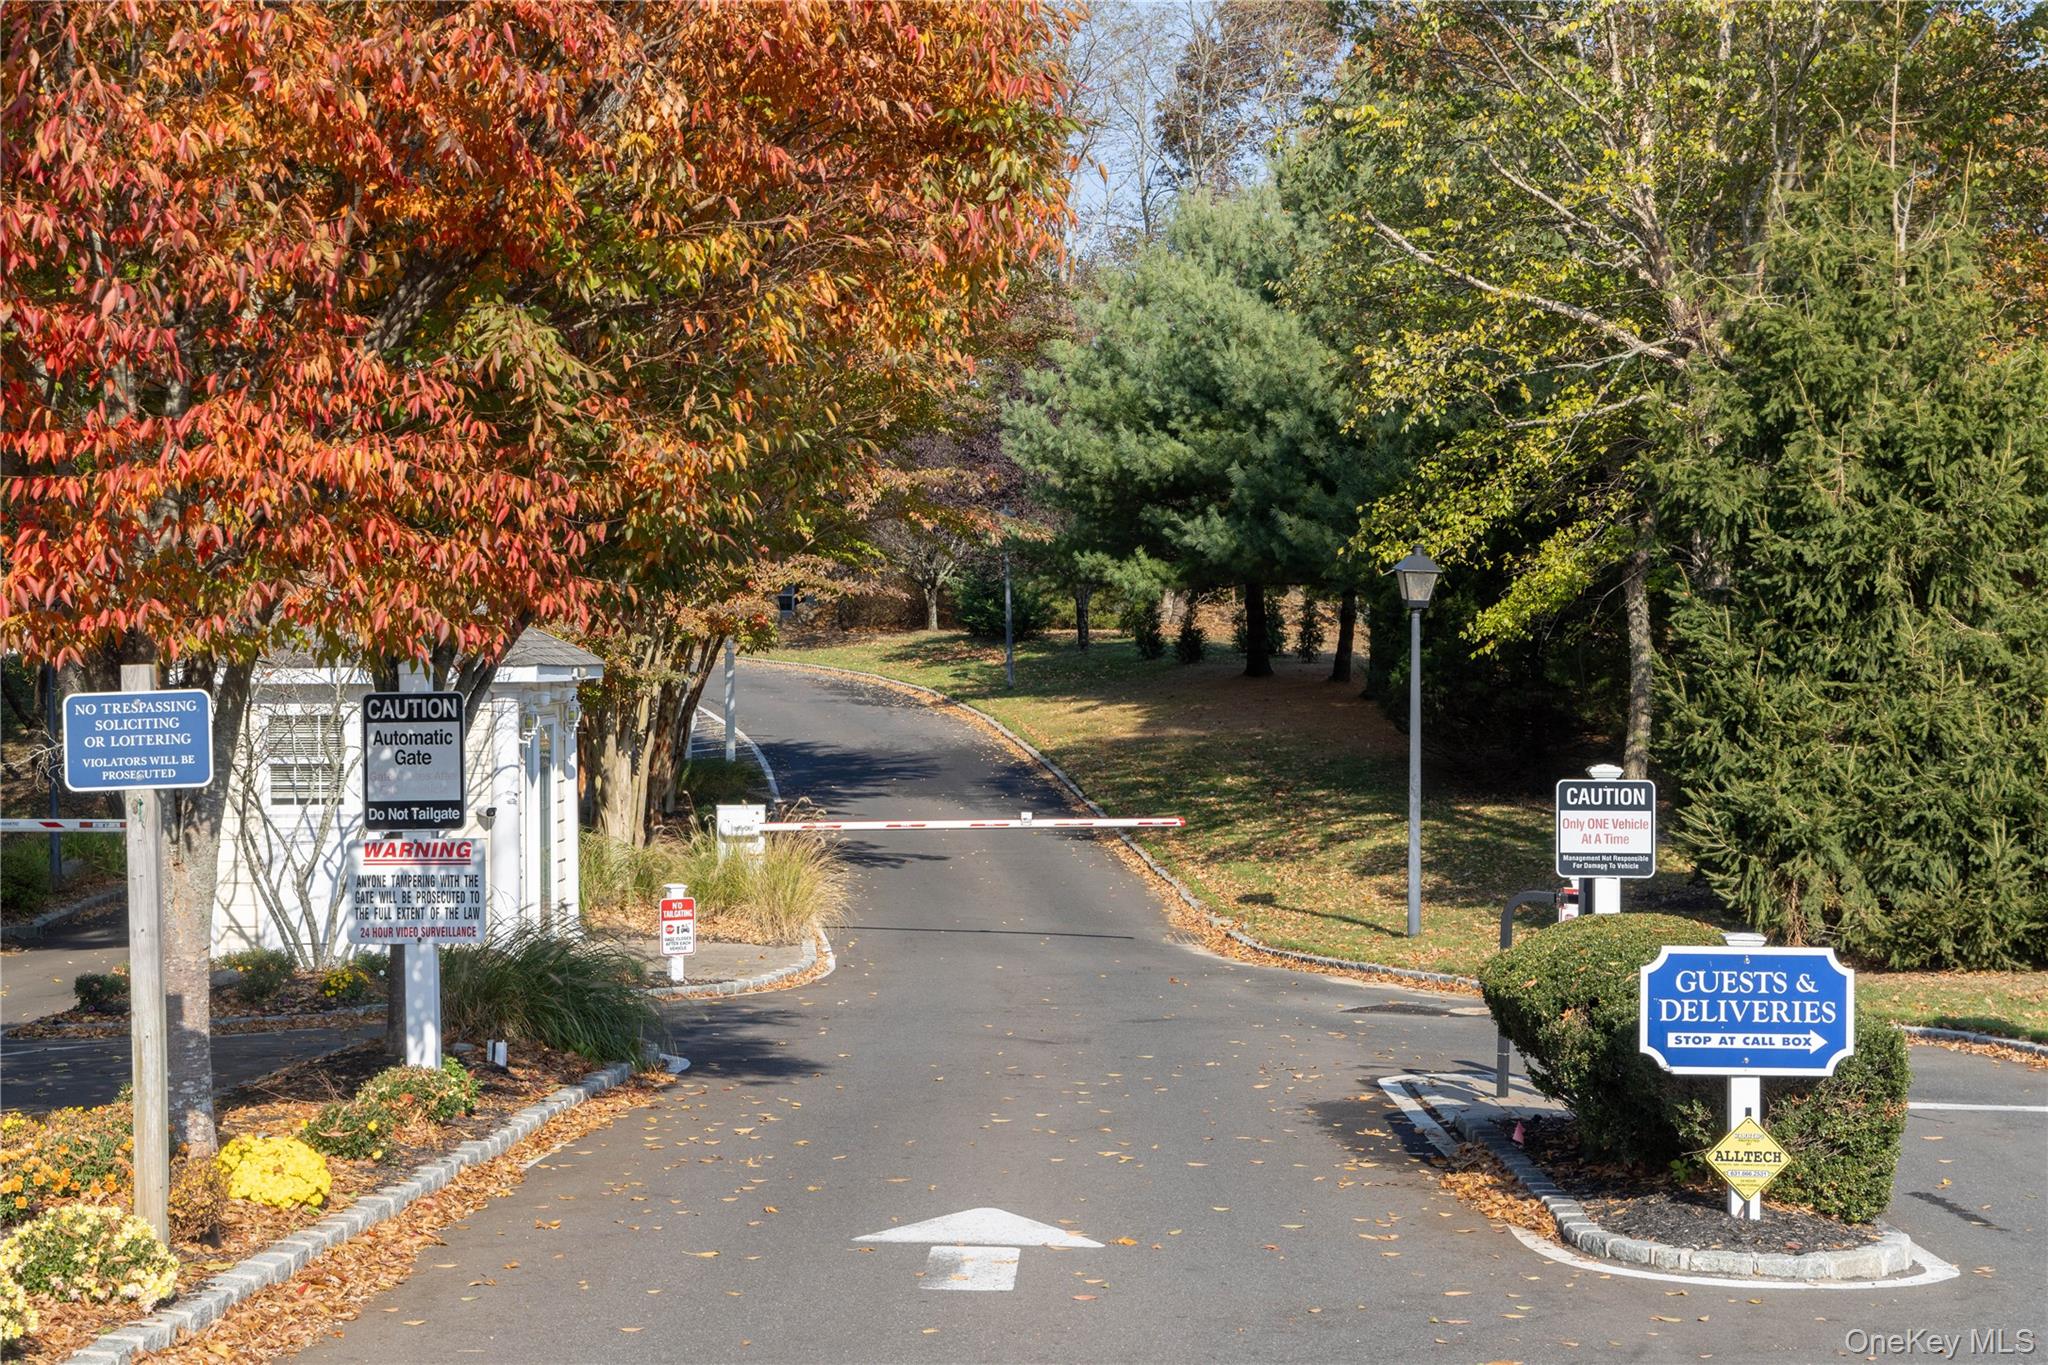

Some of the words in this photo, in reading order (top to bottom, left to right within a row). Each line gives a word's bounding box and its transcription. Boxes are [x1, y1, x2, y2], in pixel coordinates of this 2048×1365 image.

[75, 703, 97, 716] NO
[101, 700, 197, 715] TRESPASSING
[367, 698, 457, 719] CAUTION
[95, 717, 180, 731] SOLICITING
[84, 736, 105, 748] OR
[110, 733, 192, 747] LOITERING
[373, 729, 453, 746] Automatic
[82, 757, 147, 768] VIOLATORS
[149, 755, 179, 766] WILL
[181, 754, 195, 765] BE
[395, 749, 432, 766] Gate
[102, 769, 176, 781] PROSECUTED
[1566, 787, 1646, 806] CAUTION
[368, 808, 386, 821] Do
[387, 807, 409, 821] Not
[411, 806, 461, 823] Tailgate
[1562, 818, 1585, 831] Only
[1587, 818, 1609, 830] ONE
[1611, 818, 1649, 830] Vehicle
[1581, 833, 1592, 845] At
[1594, 833, 1602, 845] A
[1604, 833, 1630, 845] Time
[363, 841, 473, 858] WARNING
[1563, 854, 1601, 862] Management
[1613, 854, 1649, 863] Responsible
[1583, 863, 1607, 871] Damage
[356, 874, 387, 888] ANYONE
[391, 874, 436, 888] TAMPERING
[439, 874, 460, 888] WITH
[463, 874, 479, 888] THE
[355, 890, 375, 904] GATE
[378, 890, 397, 904] WILL
[401, 890, 412, 904] BE
[416, 890, 466, 904] PROSECUTED
[470, 890, 480, 903] TO
[355, 907, 370, 921] THE
[374, 907, 392, 921] FULL
[397, 907, 425, 921] EXTENT
[430, 907, 440, 920] OF
[445, 906, 459, 920] THE
[463, 906, 480, 920] LAW
[360, 927, 370, 938] 24
[371, 927, 394, 938] HOUR
[396, 926, 419, 938] VIDEO
[420, 925, 477, 938] SURVEILLANCE
[1675, 970, 1788, 994] GUESTS
[1795, 973, 1819, 993] &
[1659, 999, 1836, 1024] DELIVERIES
[1674, 1035, 1712, 1046] STOP
[1718, 1036, 1737, 1046] AT
[1742, 1036, 1776, 1047] CALL
[1782, 1037, 1812, 1047] BOX
[1715, 1151, 1782, 1163] ALLTECH
